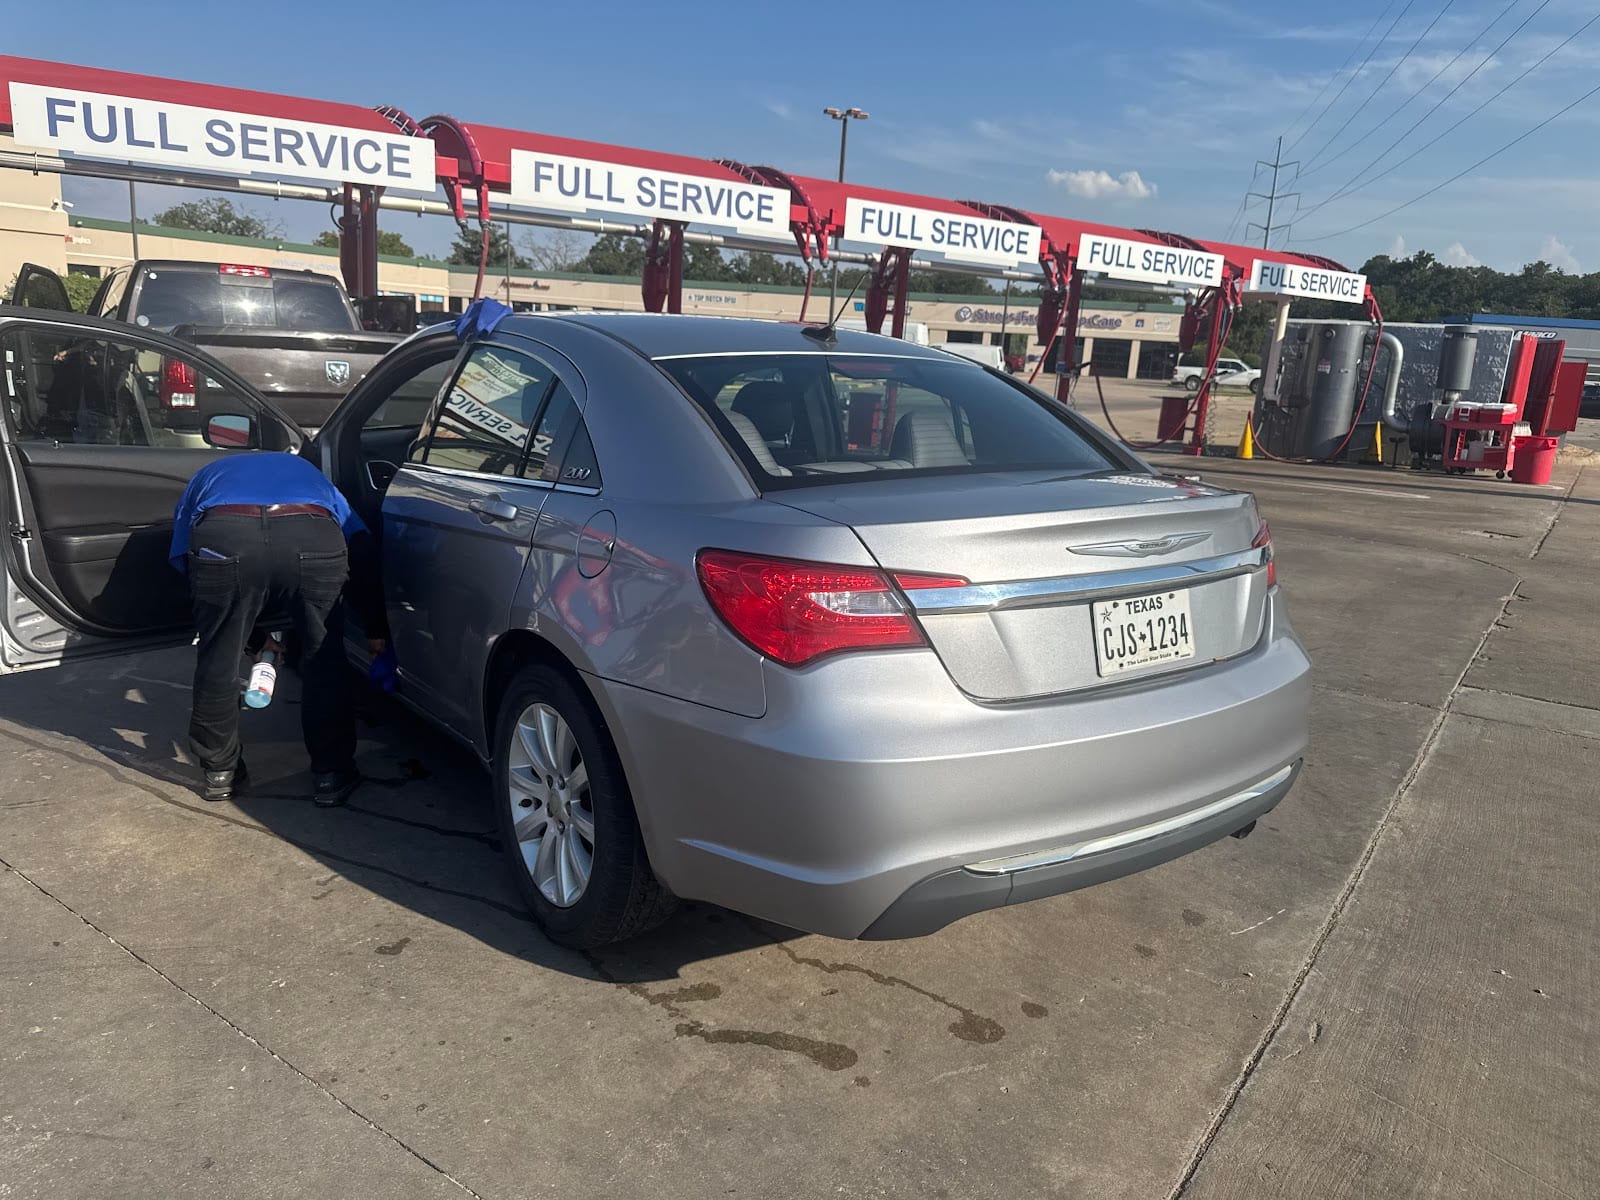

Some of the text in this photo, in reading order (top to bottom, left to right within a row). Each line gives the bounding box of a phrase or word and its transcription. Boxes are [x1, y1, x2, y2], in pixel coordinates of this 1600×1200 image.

[45, 97, 411, 178] FULL SERVICE
[534, 161, 775, 223] FULL SERVICE
[861, 207, 1030, 255] FULL SERVICE
[1089, 241, 1216, 280] FULL SERVICE
[1259, 264, 1360, 298] FULL SERVICE
[563, 466, 591, 480] 200
[1125, 596, 1164, 615] TEXAS
